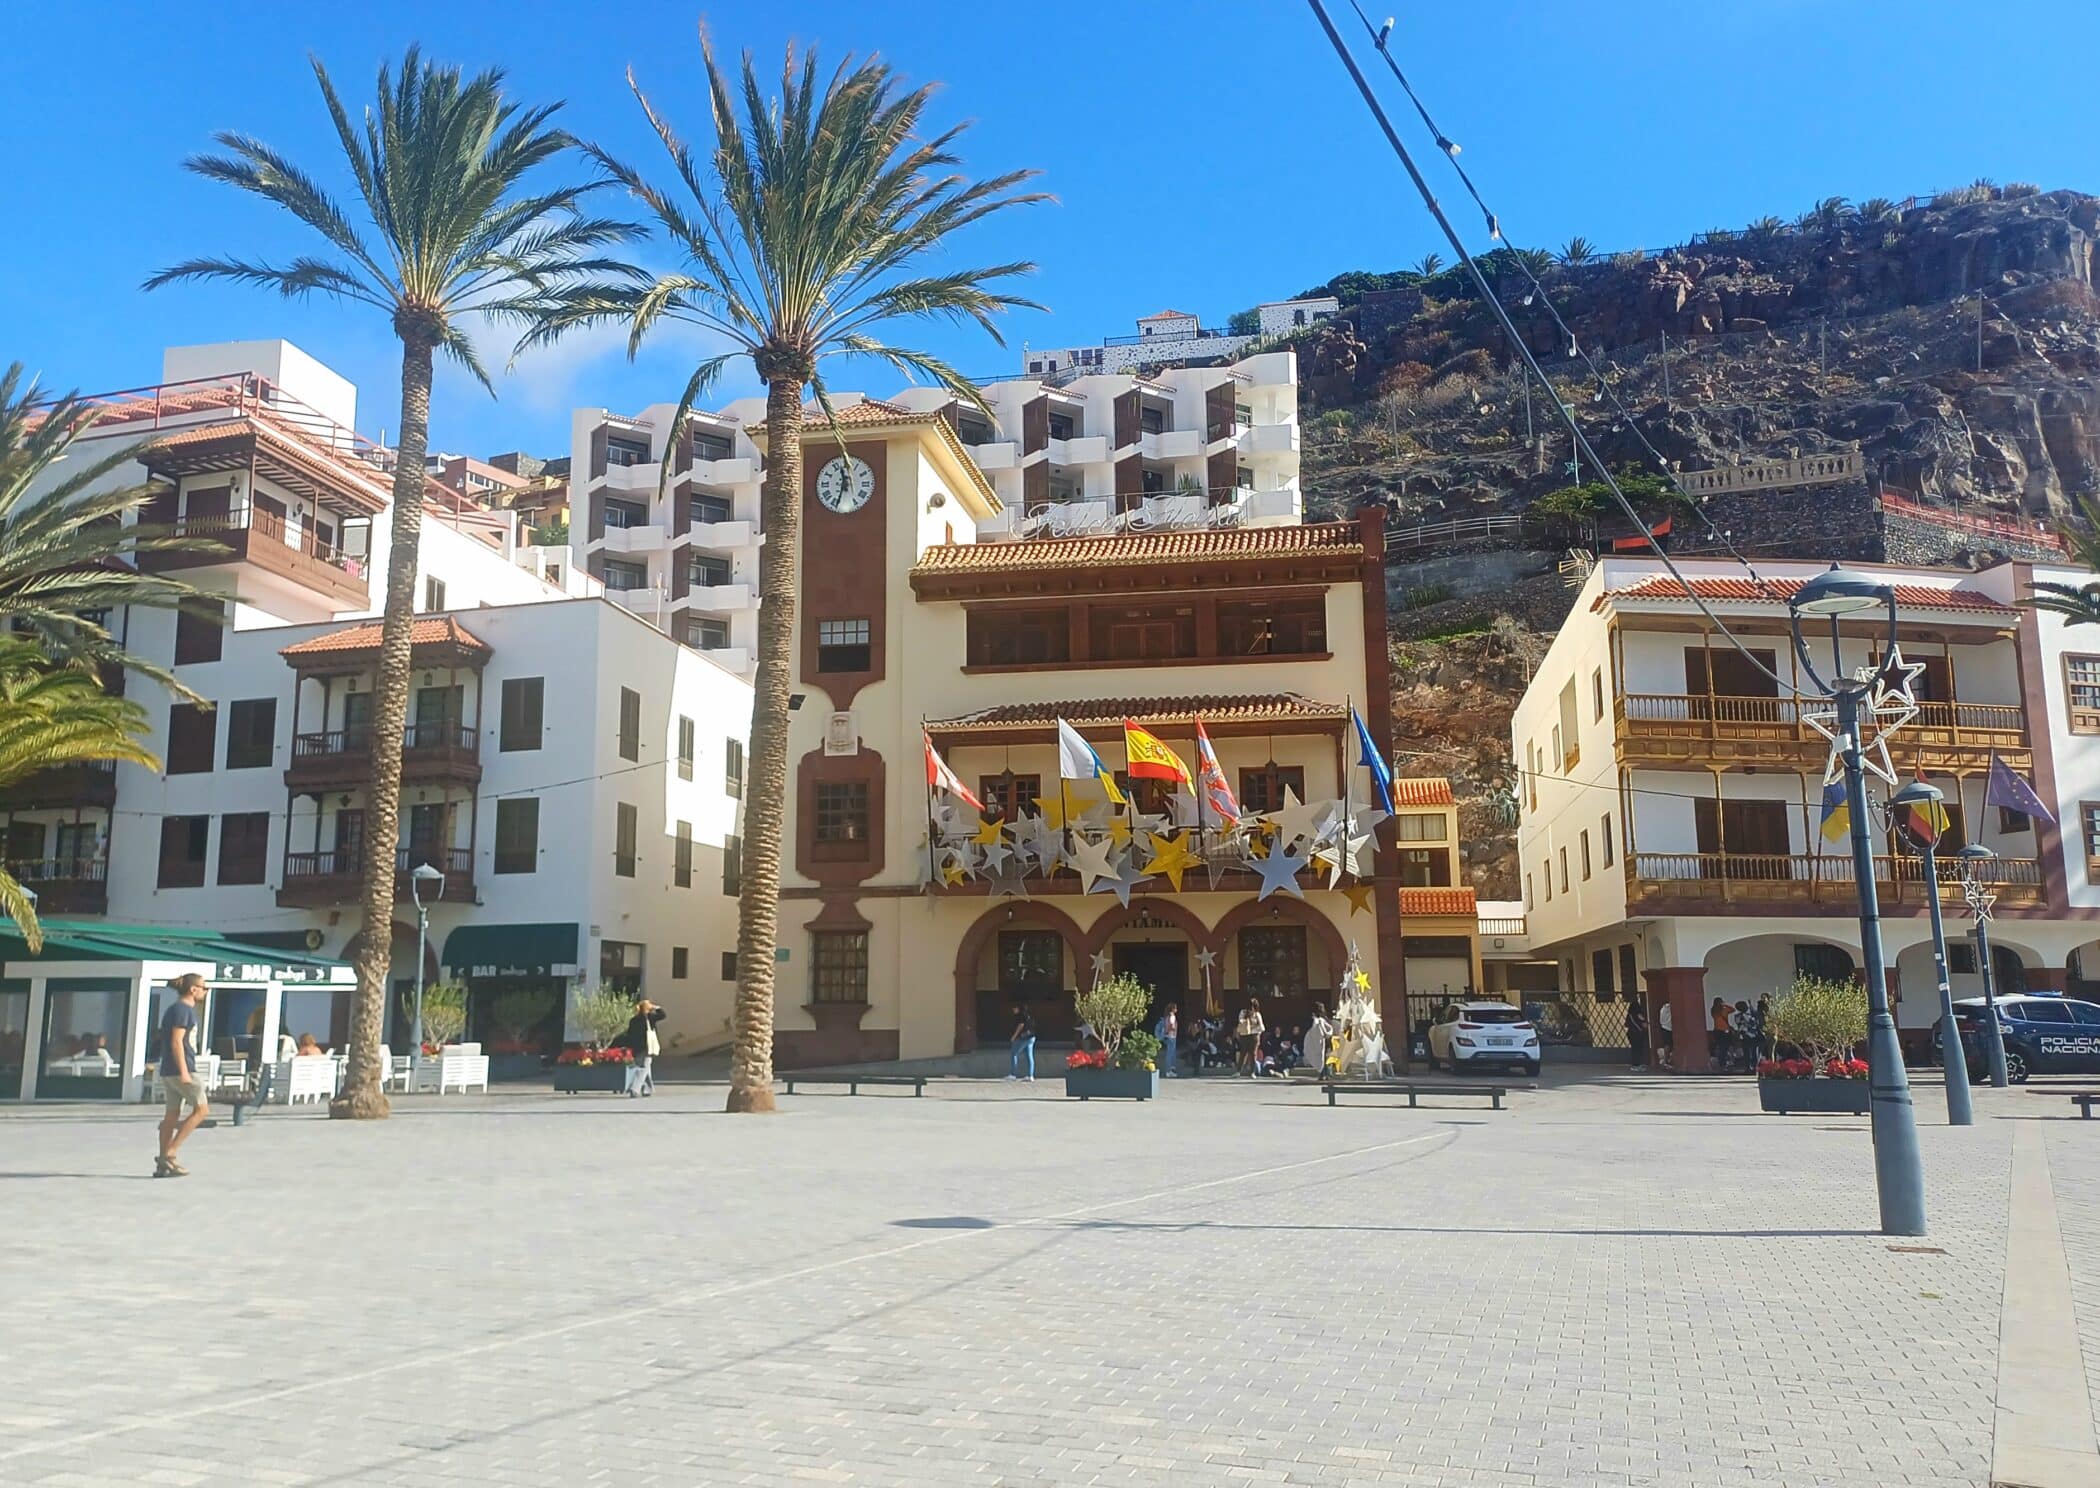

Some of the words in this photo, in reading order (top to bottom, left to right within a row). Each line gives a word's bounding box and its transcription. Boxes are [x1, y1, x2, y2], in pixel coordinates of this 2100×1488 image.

[241, 964, 272, 981] BAR
[471, 965, 497, 978] BAR
[2041, 1045, 2100, 1054] NACION
